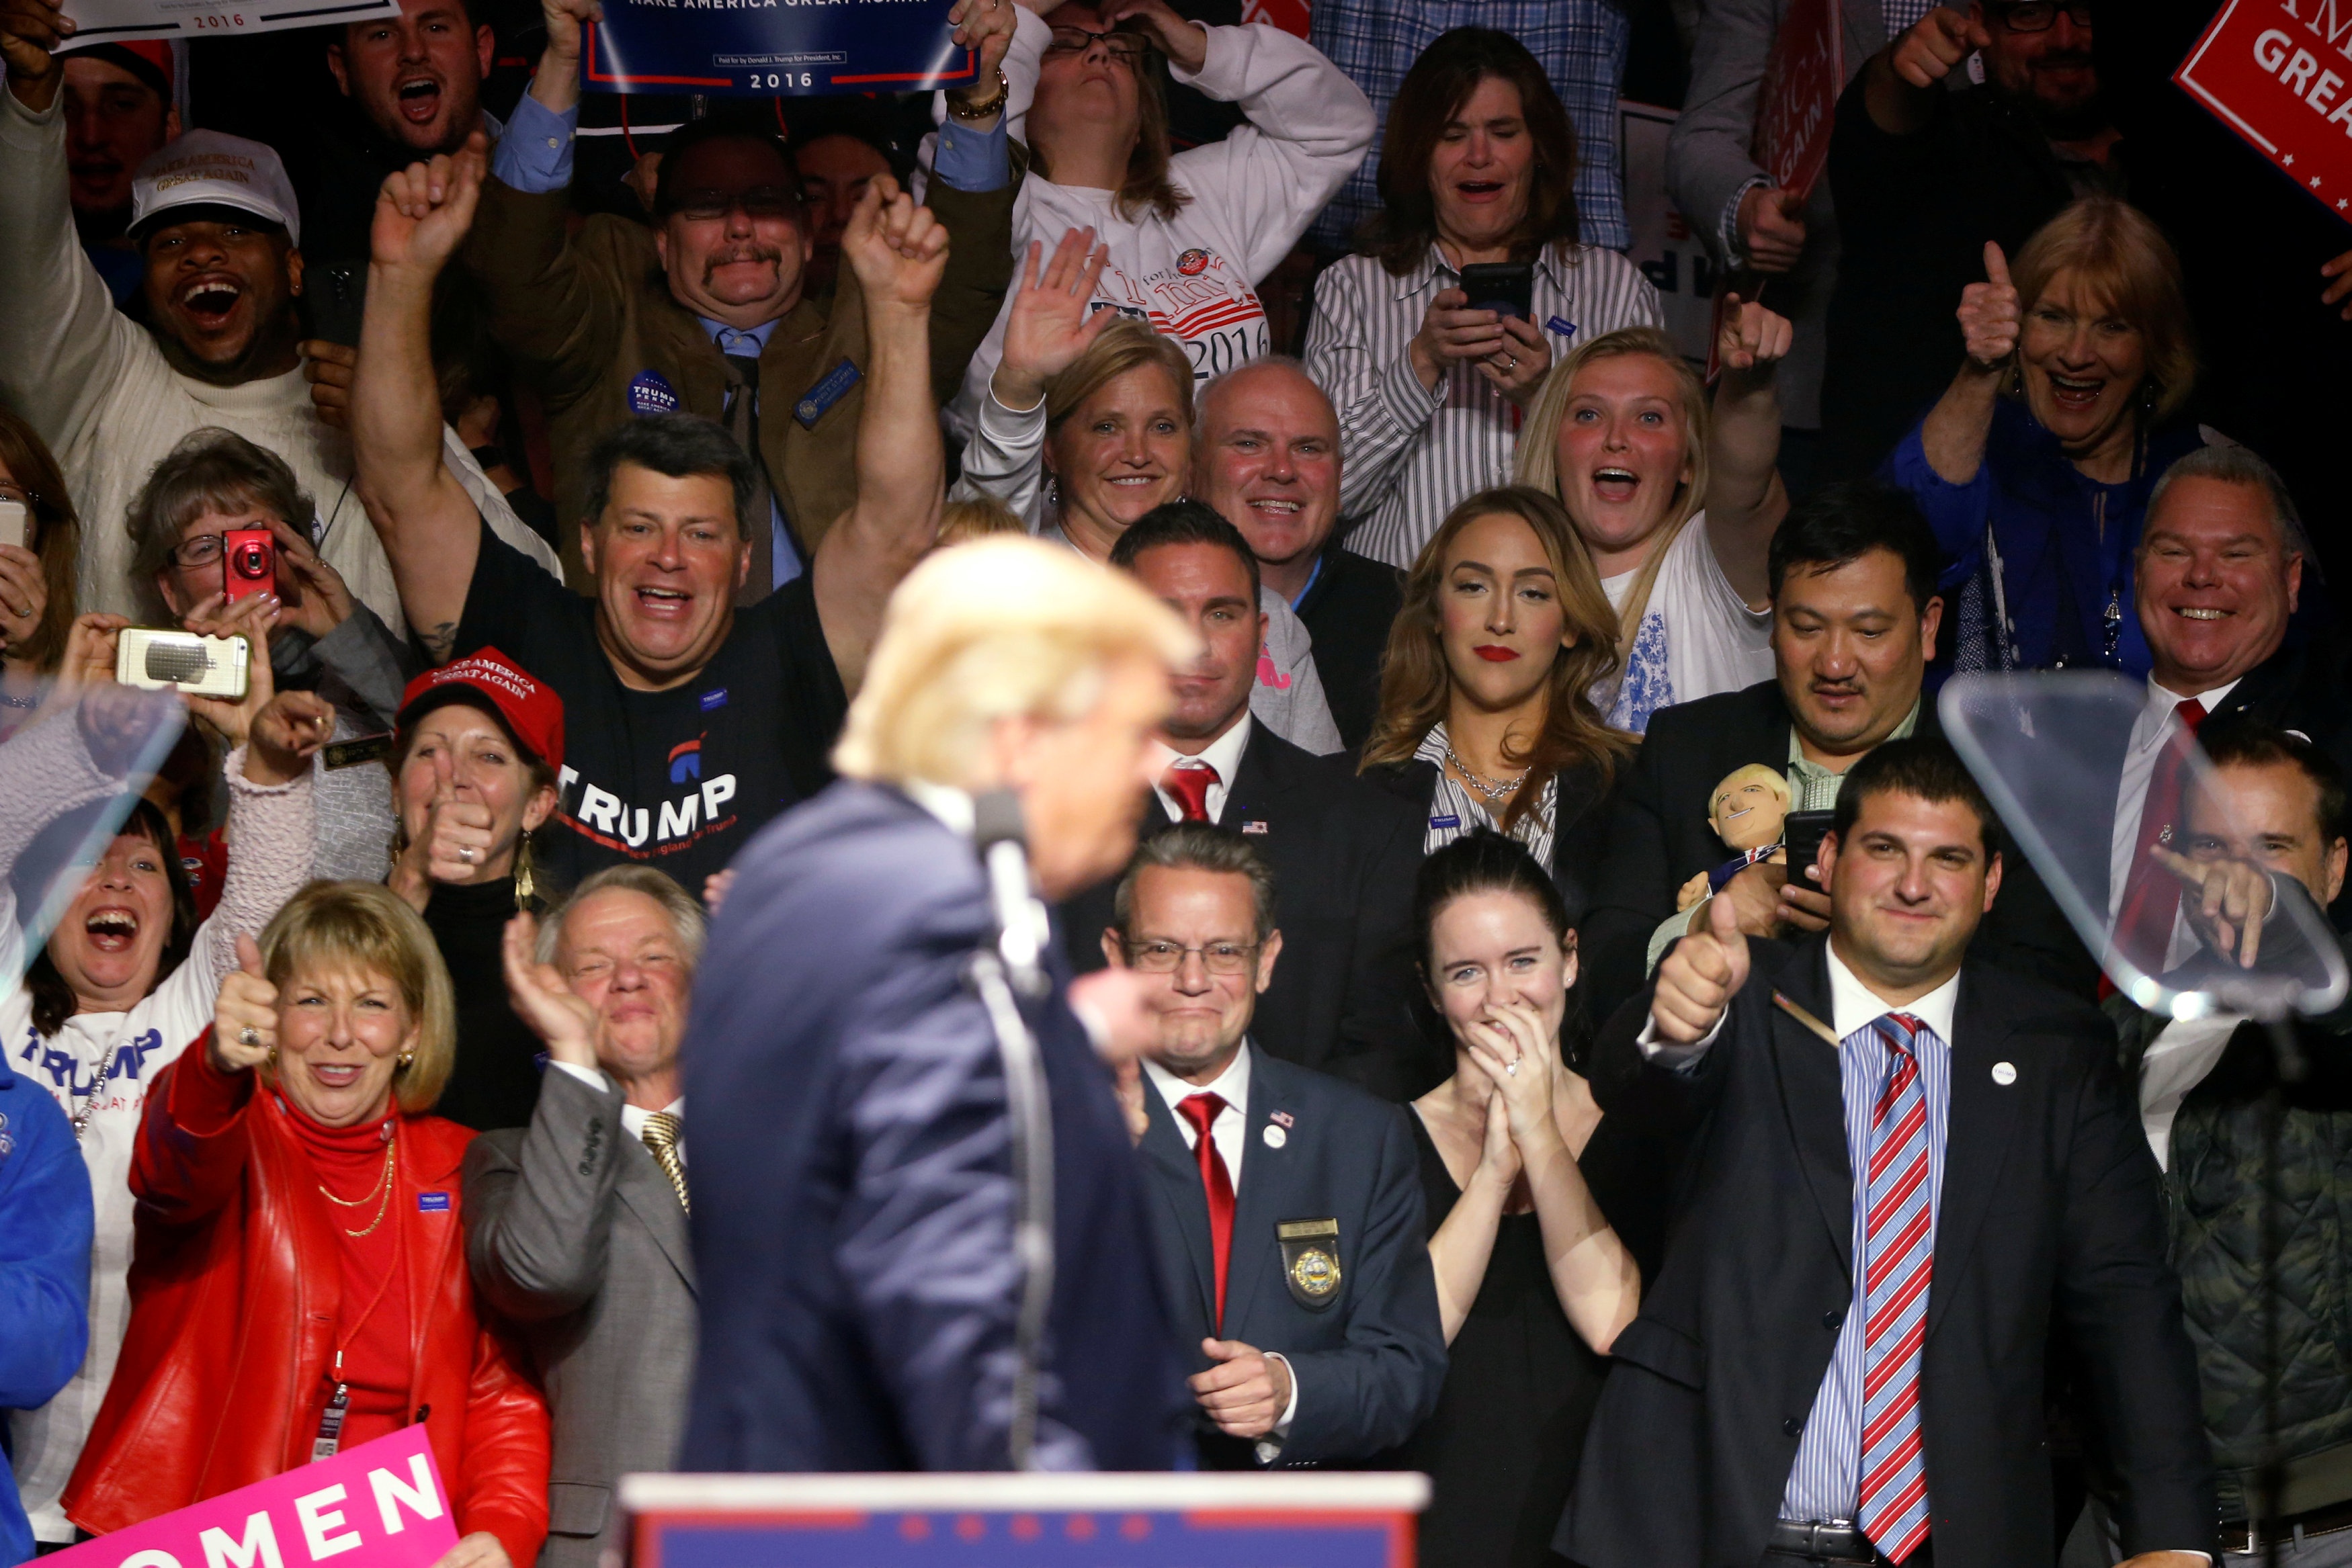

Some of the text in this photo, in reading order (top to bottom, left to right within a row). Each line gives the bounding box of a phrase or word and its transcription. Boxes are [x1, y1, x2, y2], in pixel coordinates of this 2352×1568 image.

[683, 0, 777, 9] AMERICA
[194, 13, 244, 28] 2016
[739, 56, 747, 64] by
[747, 56, 768, 64] Donald
[750, 73, 812, 88] 2016
[2253, 29, 2352, 139] GREA
[1779, 89, 1822, 186] GAIN
[187, 154, 255, 171] AMERICA
[157, 169, 249, 192] GREAT AGAIN
[1185, 321, 1269, 380] 2016
[634, 386, 675, 402] TRUMP
[636, 393, 671, 406] PENCE
[470, 658, 536, 694] AMERICA
[480, 671, 527, 700] AGAIN
[558, 763, 737, 847] TRUMP
[20, 1026, 163, 1096] TRUMP
[118, 1452, 444, 1568] MEN
